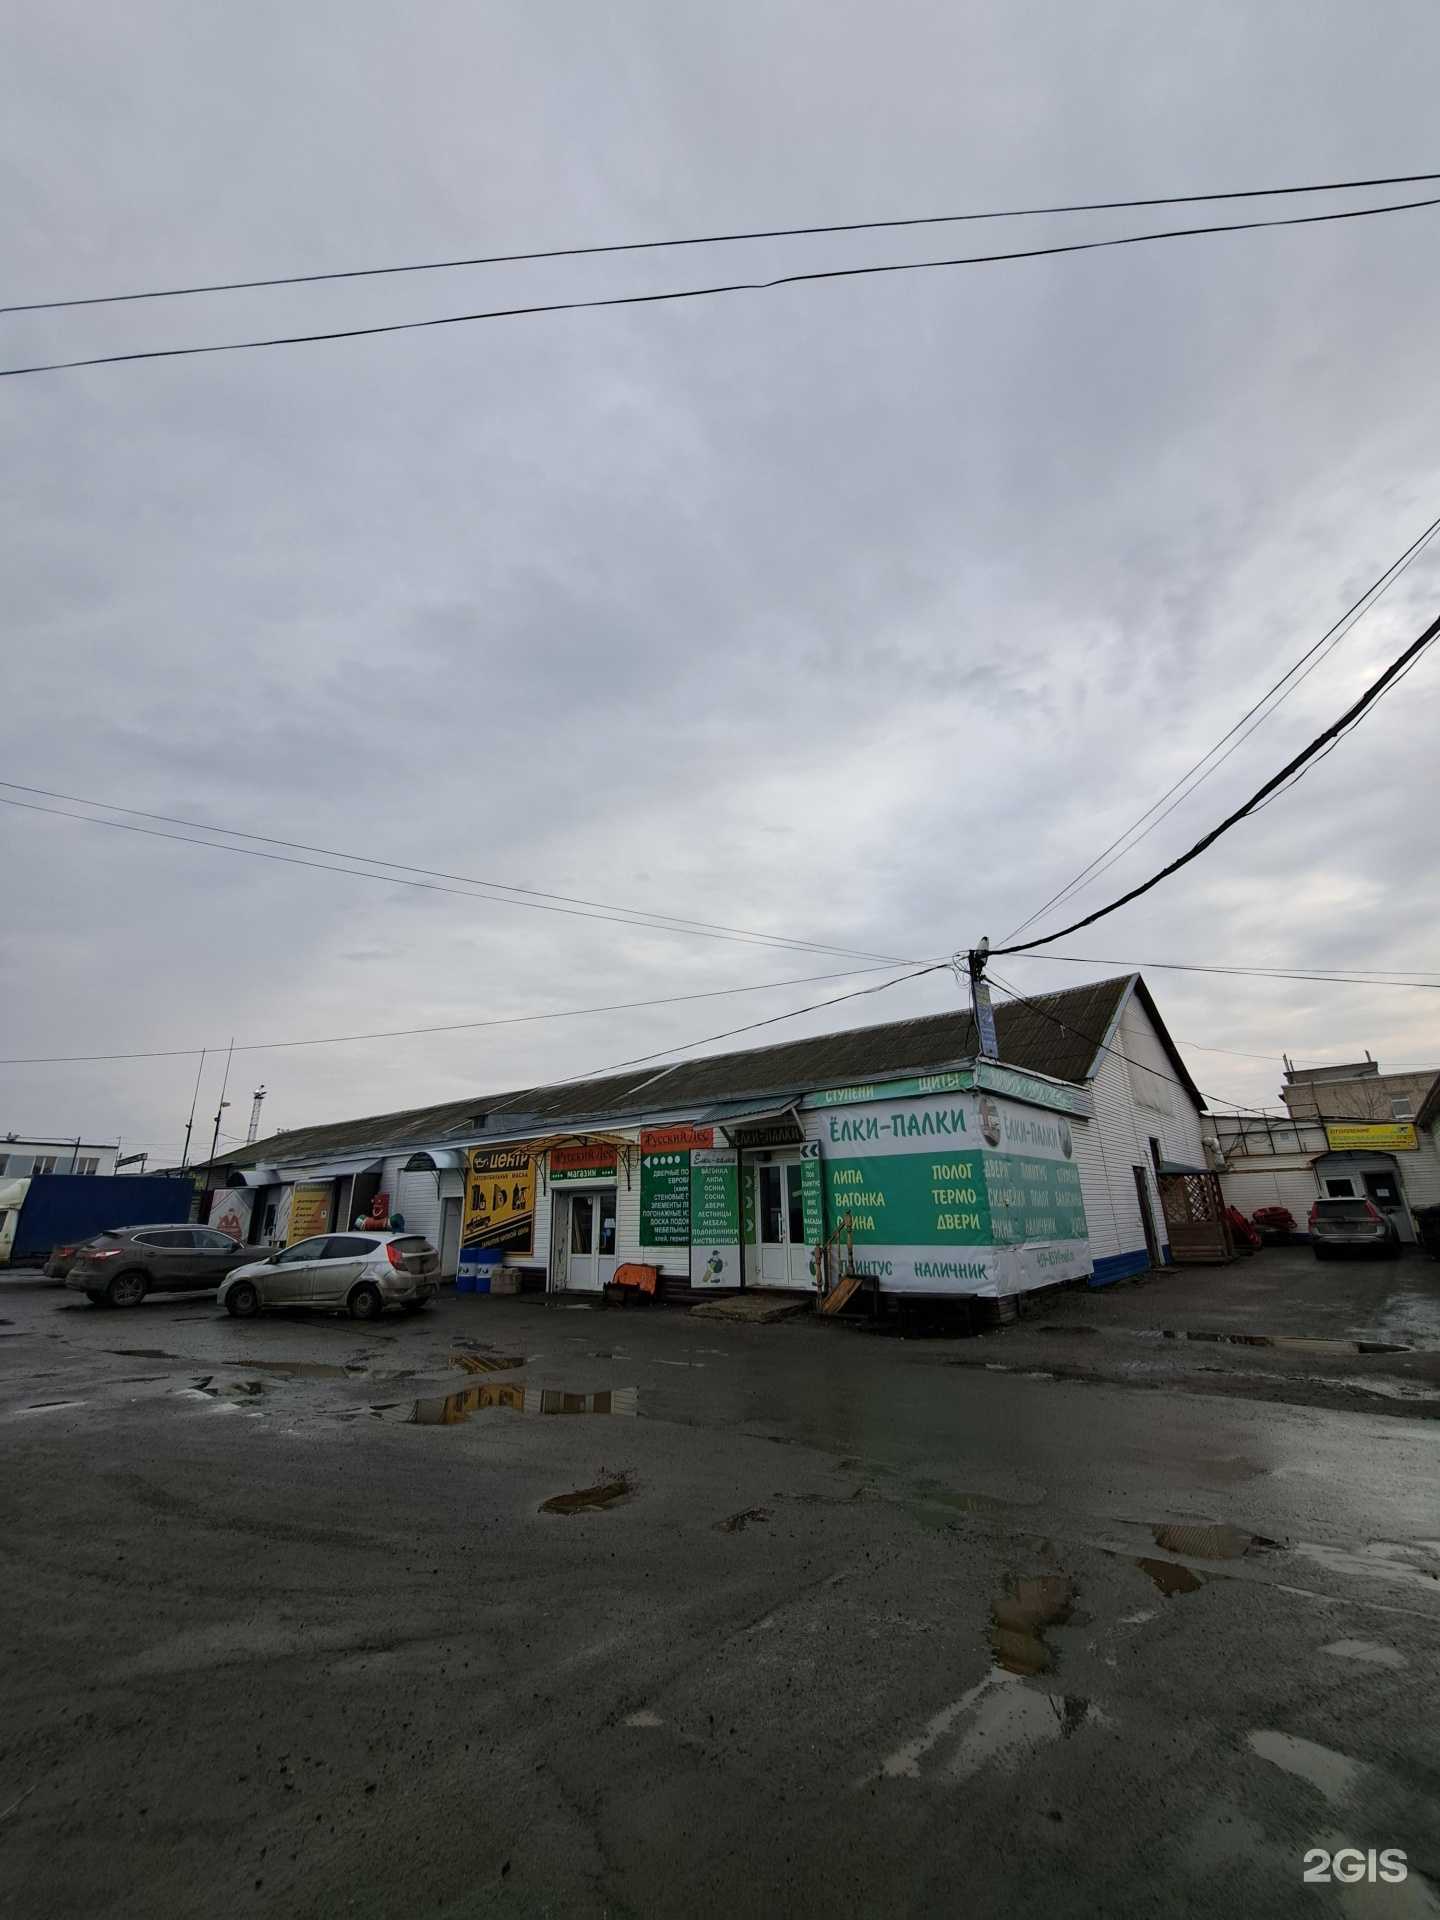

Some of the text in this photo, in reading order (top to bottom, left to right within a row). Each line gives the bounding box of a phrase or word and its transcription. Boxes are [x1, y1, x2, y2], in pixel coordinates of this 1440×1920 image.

[918, 1072, 959, 1092] ЩИТЫ
[825, 1085, 874, 1103] СТУПЕНИ
[829, 1109, 967, 1142] ЁЛКИ-ПАЛКИ
[833, 1169, 863, 1184] ЛИПА
[834, 1192, 886, 1207] ВАГОНКА
[932, 1189, 976, 1205] ТЕРМО
[837, 1215, 875, 1230] ОИНА
[937, 1213, 980, 1230] ДВЕРИ
[915, 1261, 988, 1280] НАЛИЧНИК
